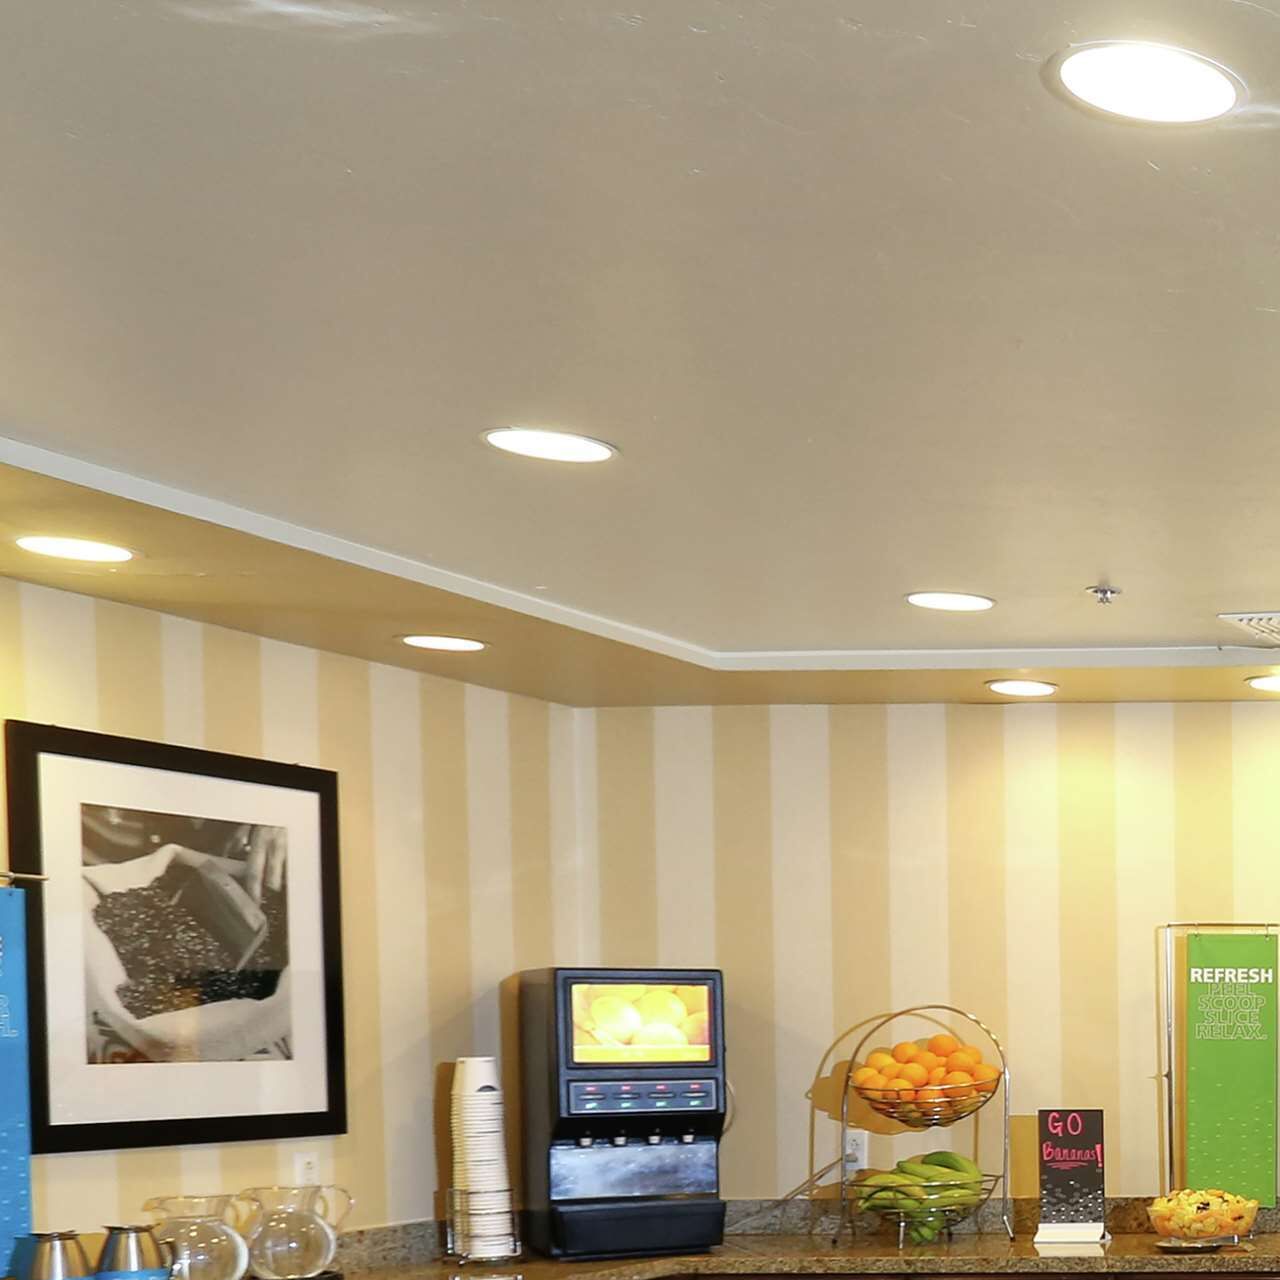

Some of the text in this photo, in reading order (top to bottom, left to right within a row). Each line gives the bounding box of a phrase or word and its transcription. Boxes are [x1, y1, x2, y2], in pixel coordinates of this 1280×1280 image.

[1190, 967, 1273, 983] REFRESH
[1199, 994, 1266, 1011] SCOOP
[1204, 1008, 1261, 1025] SLICE
[1195, 1022, 1268, 1040] RELAX.
[1048, 1111, 1082, 1136] GO
